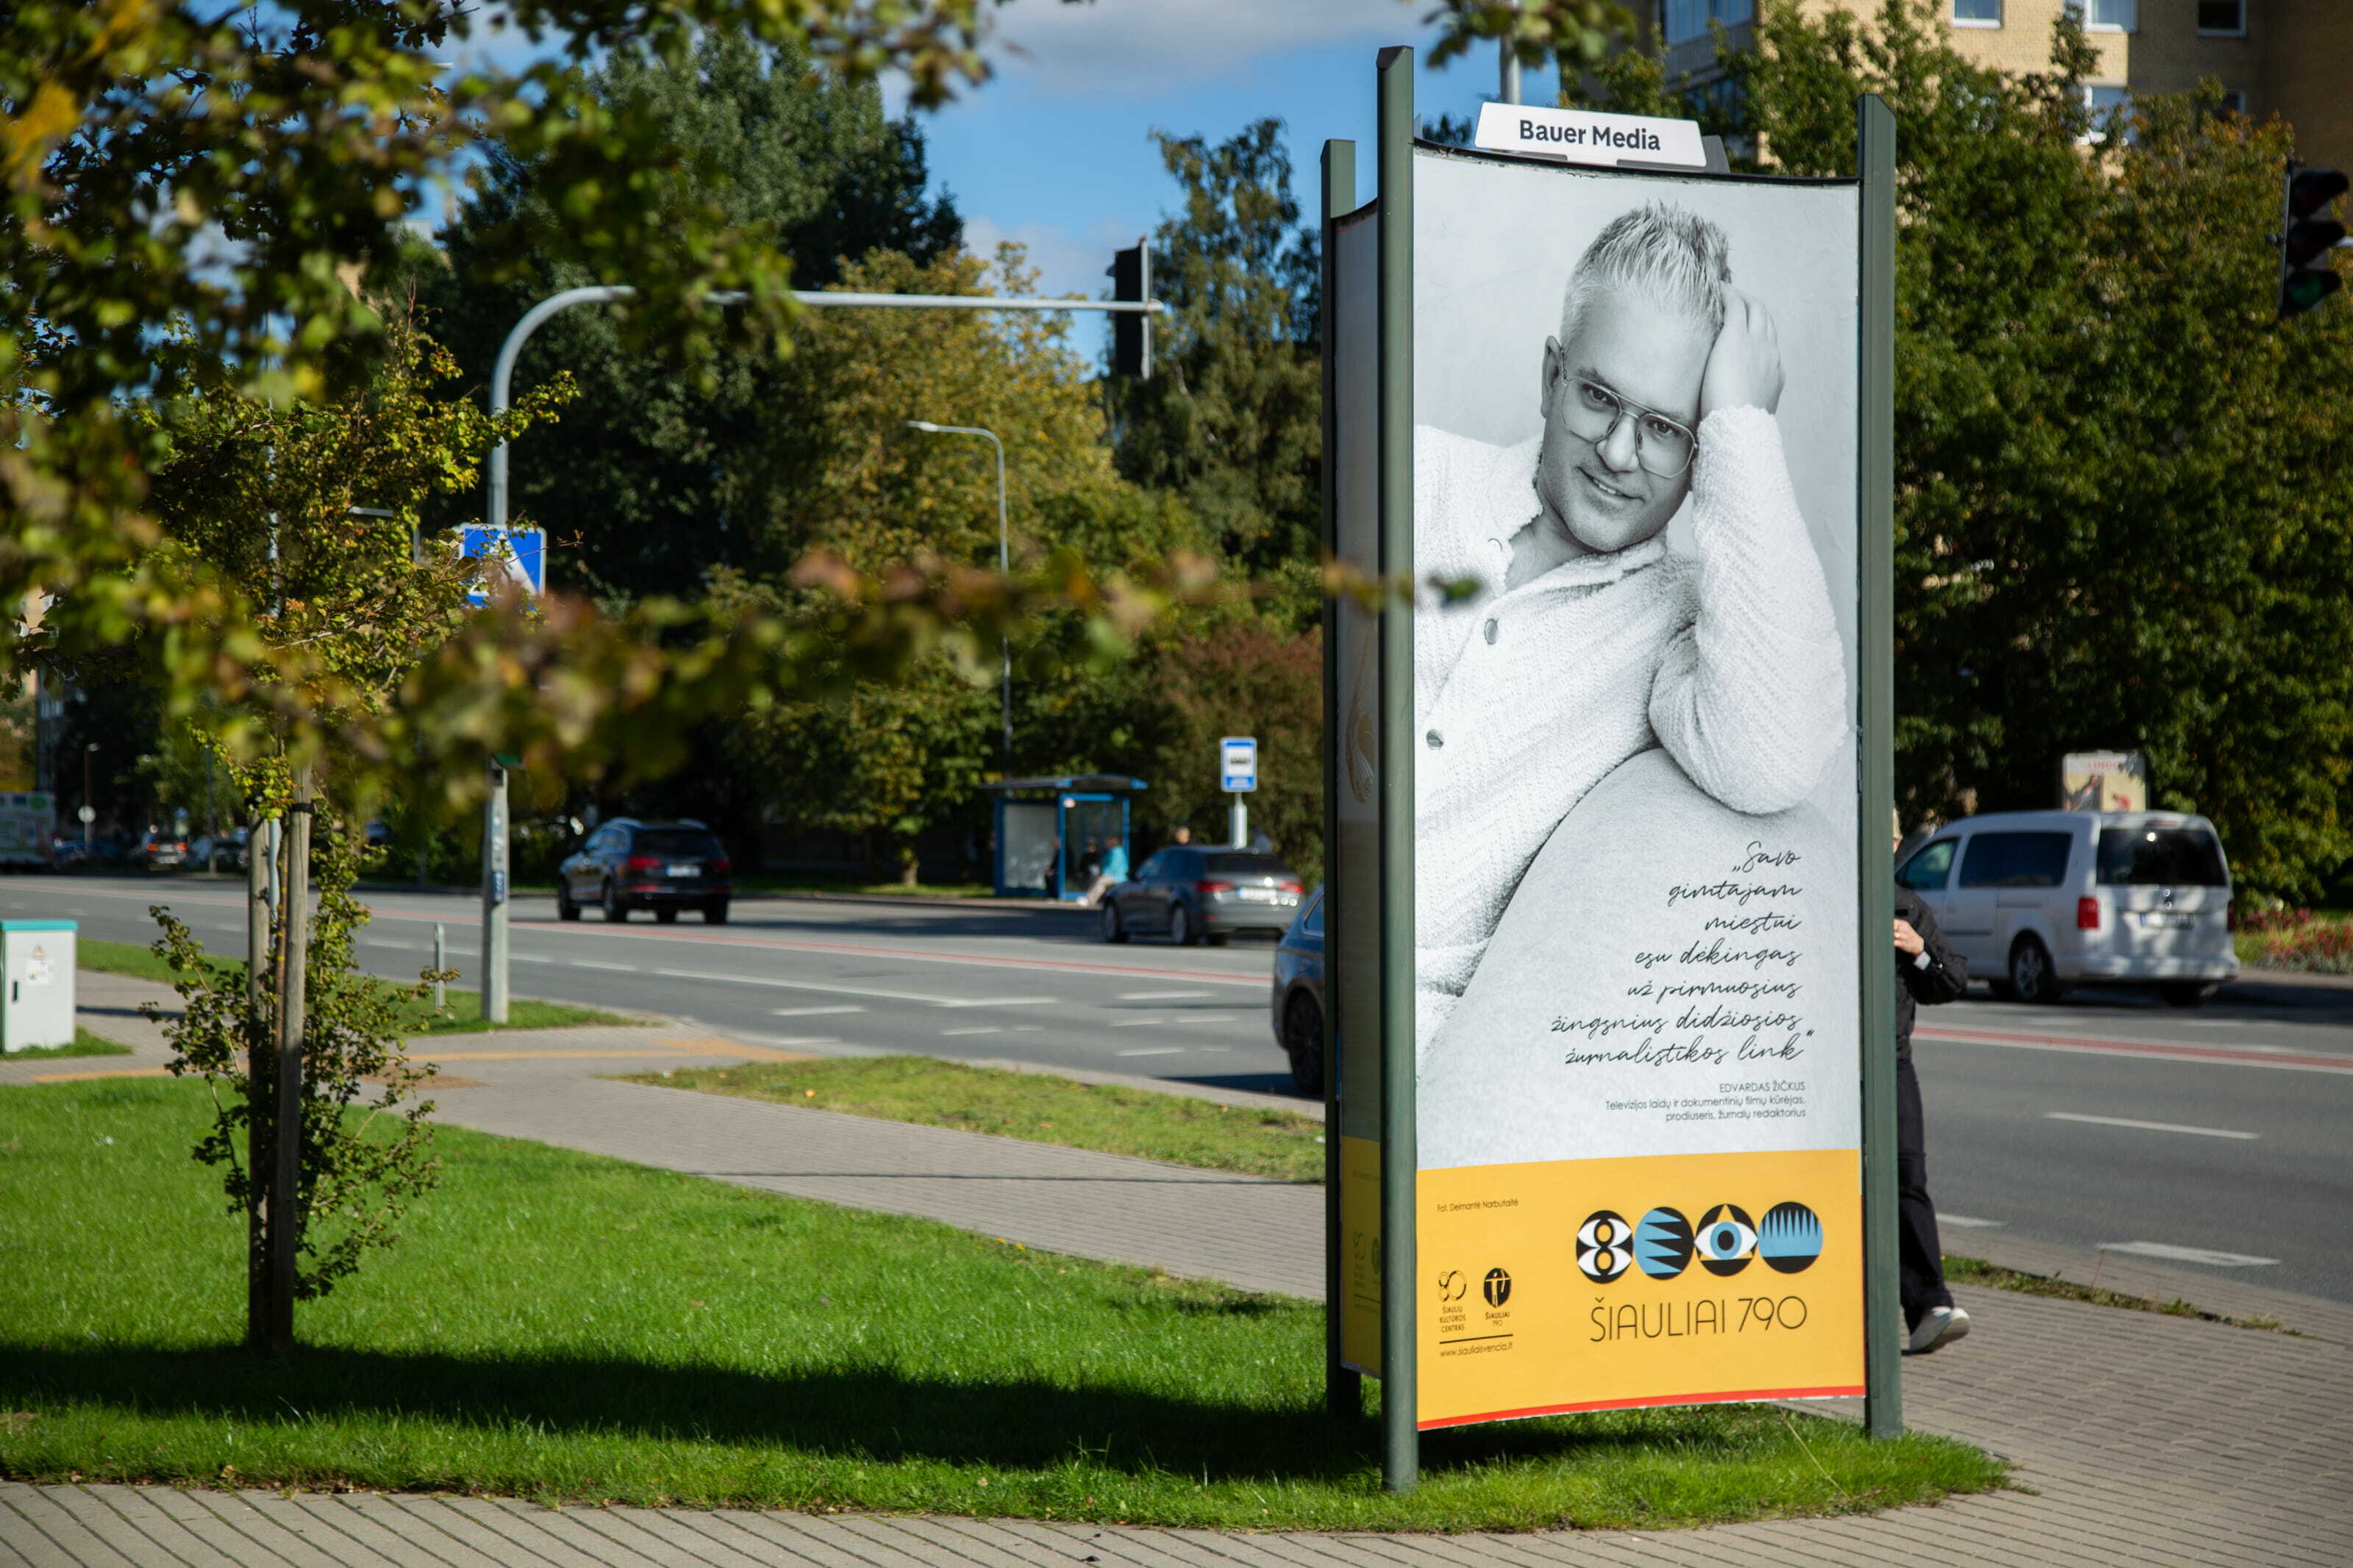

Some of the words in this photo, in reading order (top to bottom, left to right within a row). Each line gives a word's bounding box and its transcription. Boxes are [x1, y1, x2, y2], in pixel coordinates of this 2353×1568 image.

[1519, 119, 1586, 145] Bauer
[1592, 125, 1660, 151] Media
[1668, 881, 1802, 906] gimtajam
[1705, 912, 1802, 934] miestui
[1635, 951, 1673, 969] esu
[1679, 937, 1802, 970] dėkingas
[1627, 980, 1654, 998] už
[1657, 979, 1802, 1004] pirmuosius
[1552, 1015, 1669, 1039] žingsnius
[1676, 1005, 1804, 1031] didžiosios
[1565, 1037, 1729, 1067] žurnalistikos
[1719, 1081, 1770, 1093] EDVARDAS
[1773, 1080, 1806, 1092] ŽIČKUS
[1606, 1100, 1648, 1111] Televizijos
[1649, 1099, 1671, 1110] laidų
[1674, 1099, 1679, 1107] ir
[1681, 1096, 1743, 1108] dokumentinių
[1745, 1095, 1767, 1106] filmų
[1753, 1107, 1807, 1119] redaktorius
[1441, 1324, 1465, 1333] CENTRAS
[1590, 1297, 1725, 1342] ŠIAULIAI
[1738, 1296, 1808, 1333] 790
